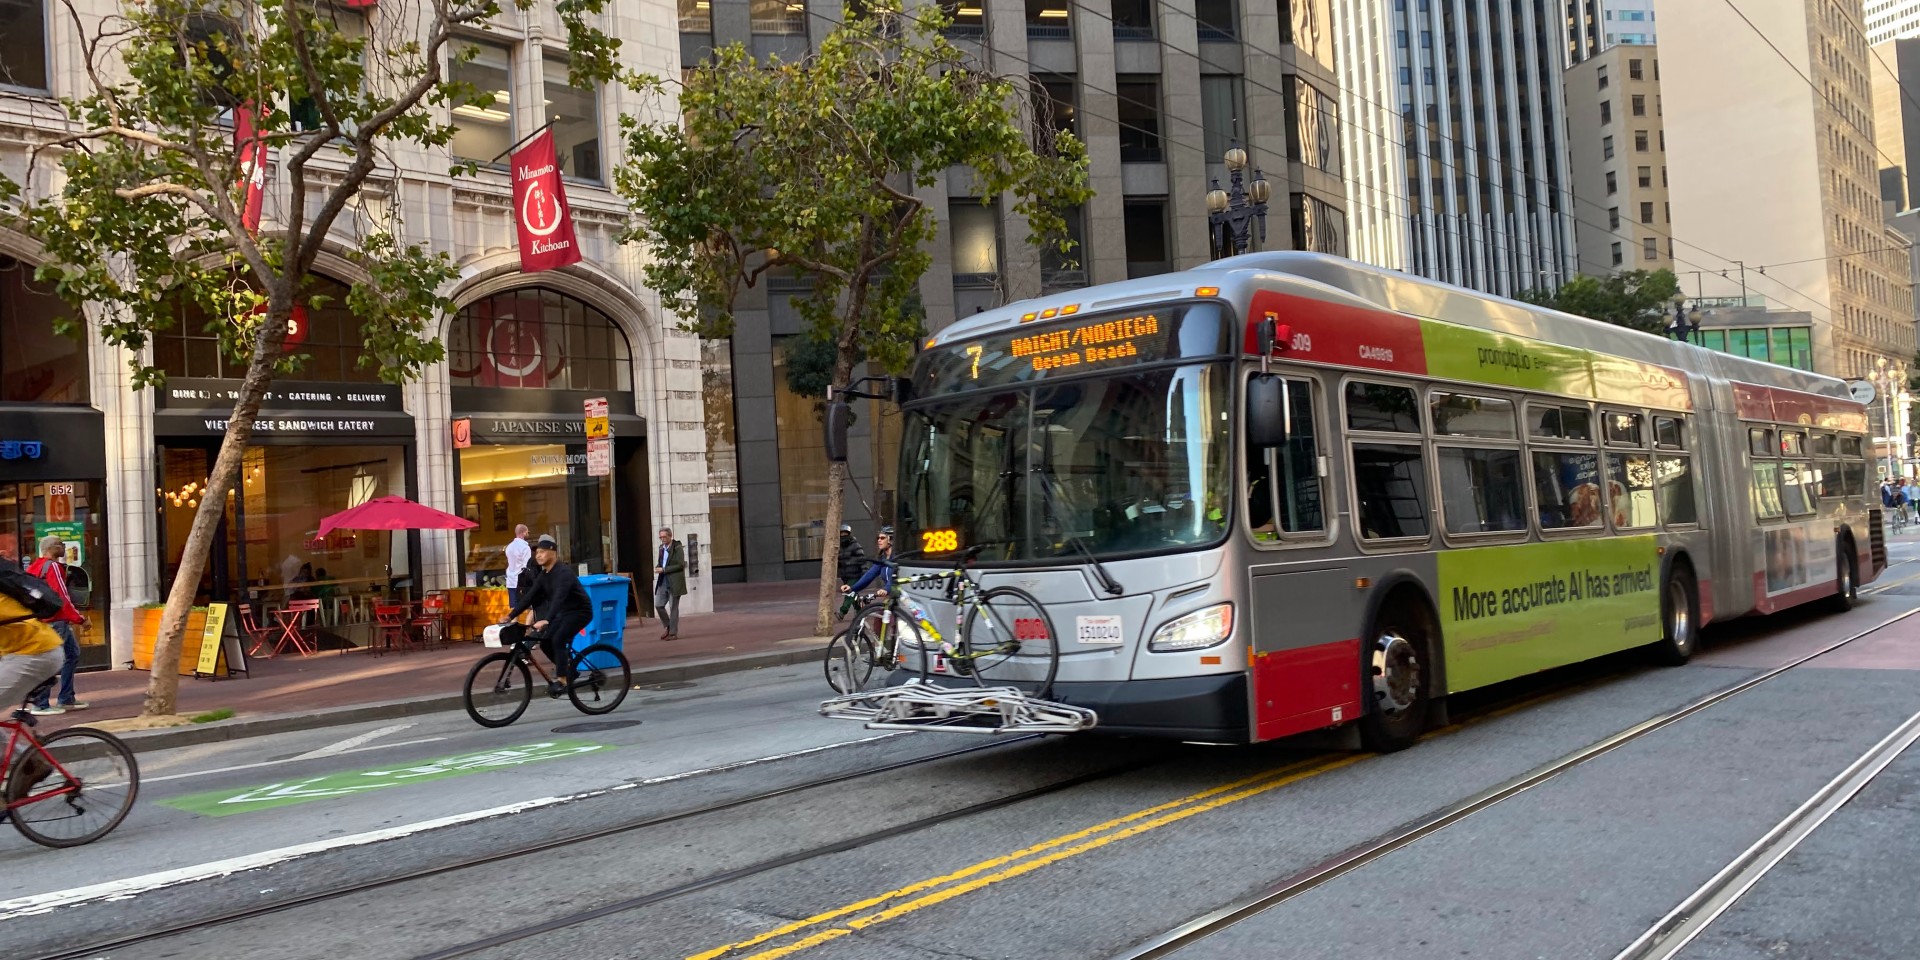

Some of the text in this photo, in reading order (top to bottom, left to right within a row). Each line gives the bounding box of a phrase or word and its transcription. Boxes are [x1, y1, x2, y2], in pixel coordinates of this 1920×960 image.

[518, 163, 554, 181] Minamoto
[531, 238, 570, 255] Kitchoan
[1011, 315, 1158, 358] HAIGHT/NORIEGA
[967, 345, 983, 379] 7
[1032, 341, 1137, 371] Ocean Beach
[172, 389, 197, 399] DINE
[288, 392, 332, 402] CATERING
[347, 393, 387, 402] DELIVERY
[204, 420, 375, 431] VIETESE SANDWICH EATERY
[491, 421, 561, 433] JAPANESE
[50, 484, 73, 495] 652
[922, 530, 958, 553] 288
[1453, 585, 1497, 621] More
[1502, 574, 1565, 614] accurate
[1569, 571, 1582, 601] AI
[1586, 569, 1610, 598] has
